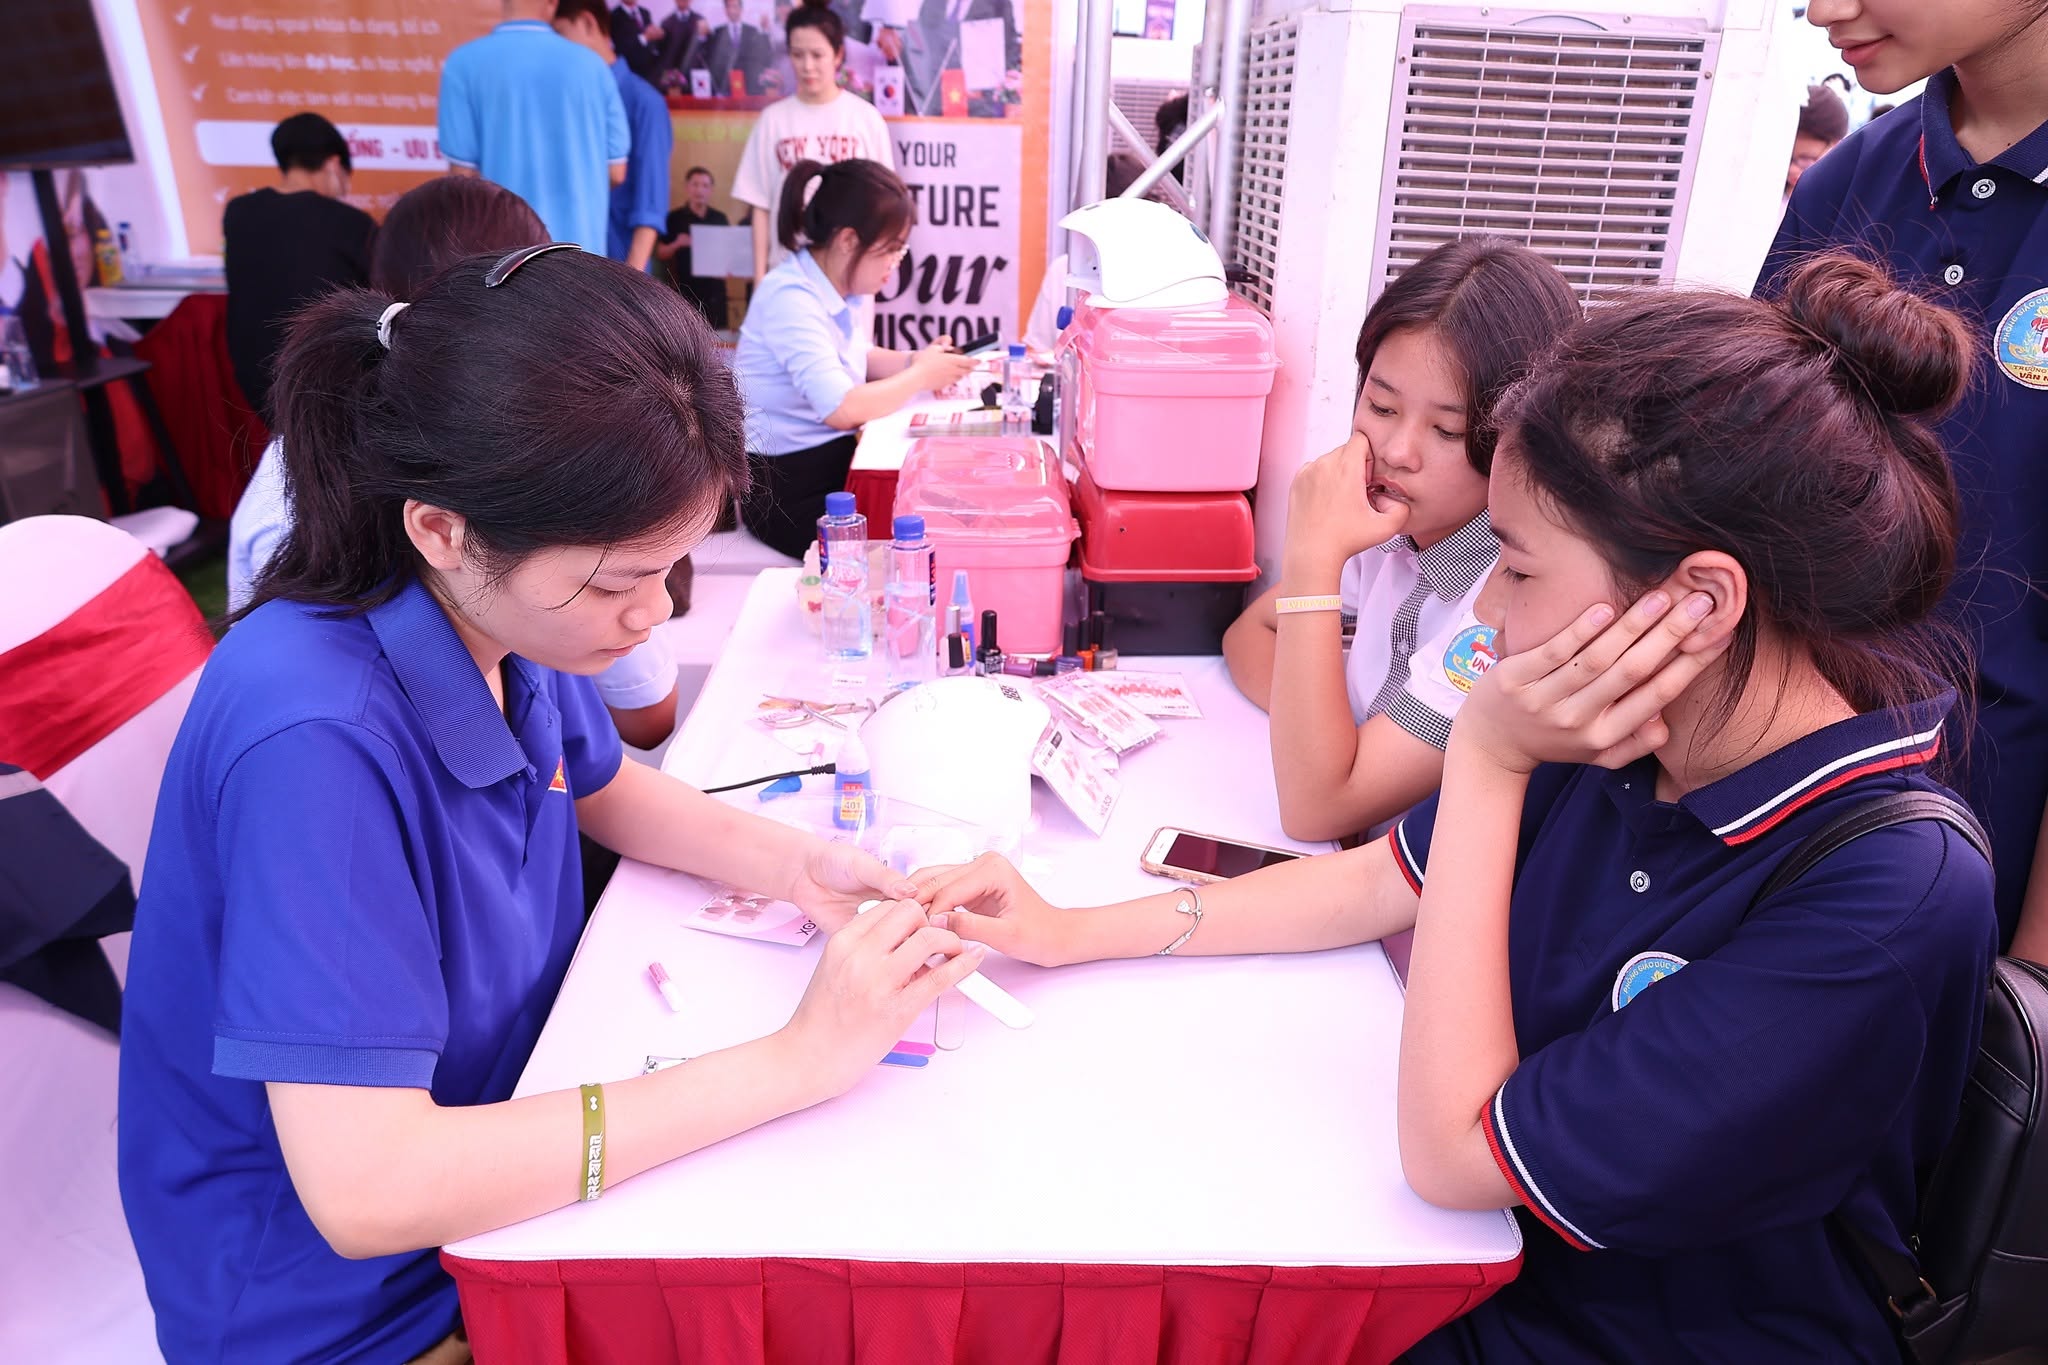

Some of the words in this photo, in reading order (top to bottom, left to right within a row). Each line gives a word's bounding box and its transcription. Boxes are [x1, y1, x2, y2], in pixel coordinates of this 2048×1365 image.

[898, 142, 956, 168] YOUR
[907, 185, 999, 227] TURE
[1472, 656, 1490, 673] VN
